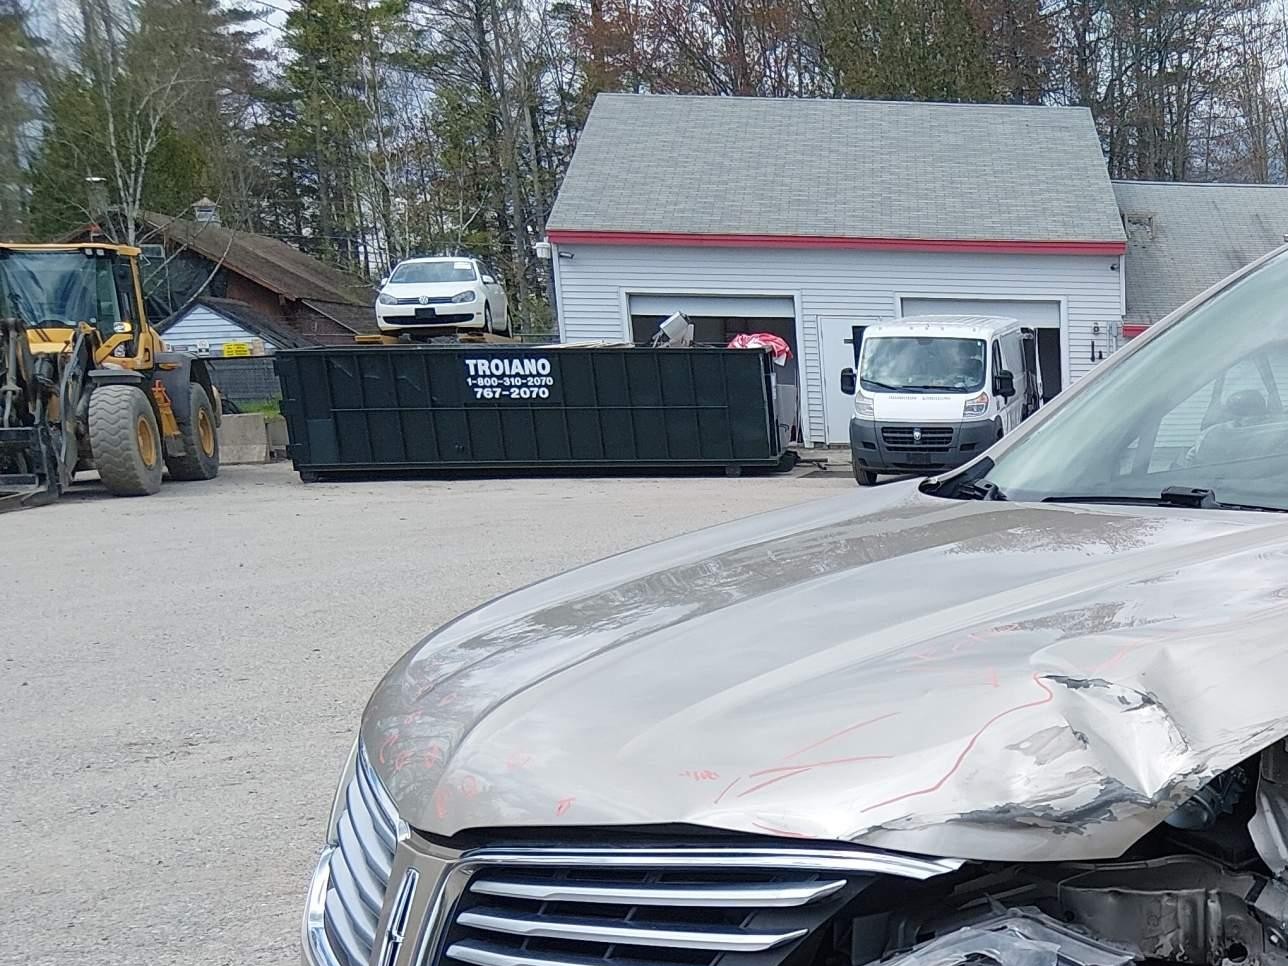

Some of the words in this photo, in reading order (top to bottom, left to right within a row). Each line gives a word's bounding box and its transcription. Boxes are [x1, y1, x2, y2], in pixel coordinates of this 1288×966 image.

[465, 358, 551, 375] TROIANO
[466, 377, 554, 386] 1-800-310-2070
[473, 387, 550, 399] 767-2070
